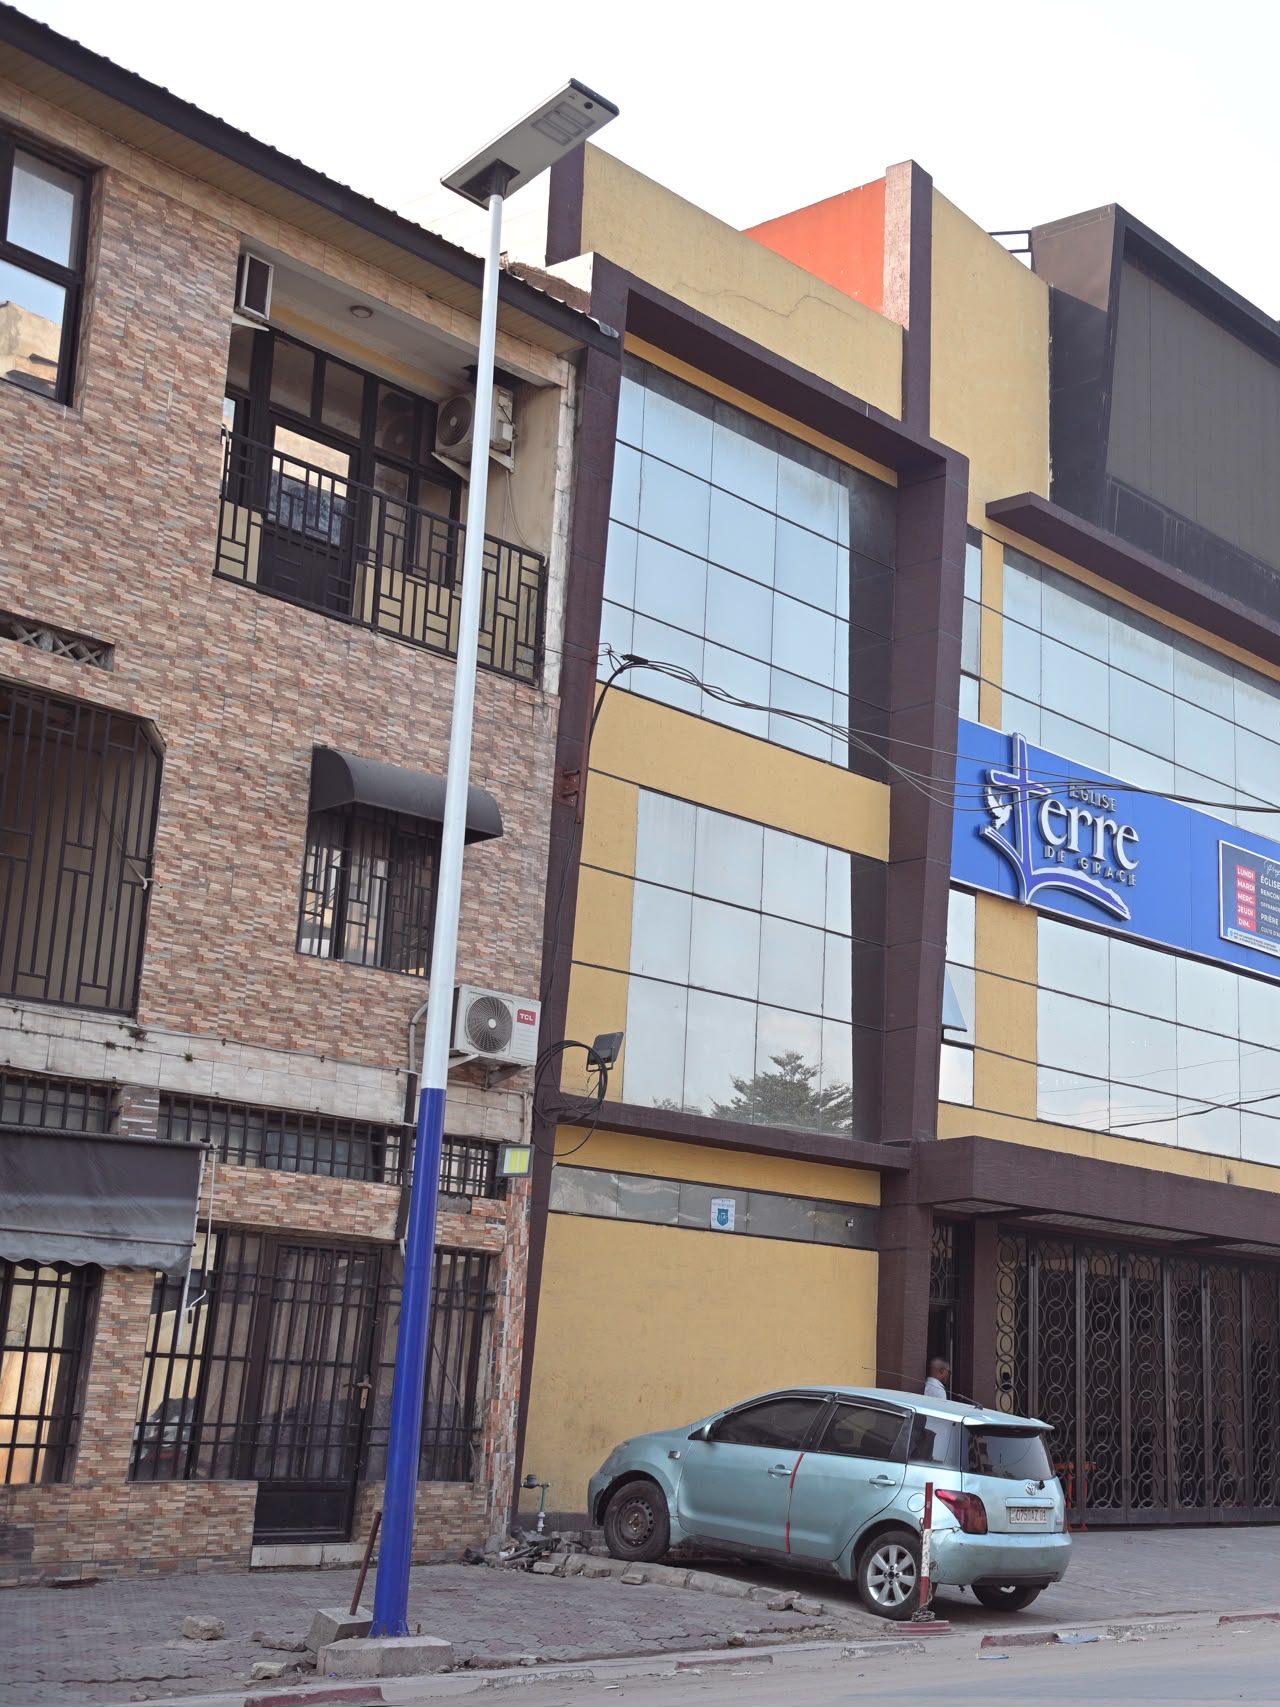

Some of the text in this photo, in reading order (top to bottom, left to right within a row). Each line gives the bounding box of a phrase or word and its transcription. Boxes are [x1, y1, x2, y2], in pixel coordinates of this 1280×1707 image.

[1044, 846, 1136, 887] DE GRACE
[1237, 868, 1254, 880] LUNDI
[1237, 879, 1256, 892] MARDI
[1260, 874, 1280, 890] ÉGLISE
[1237, 892, 1254, 904] MERC.
[1237, 905, 1254, 917] JEUDI
[1238, 917, 1251, 928] DIM.
[1260, 912, 1279, 926] PRIÈRE
[519, 1012, 534, 1022] TCL
